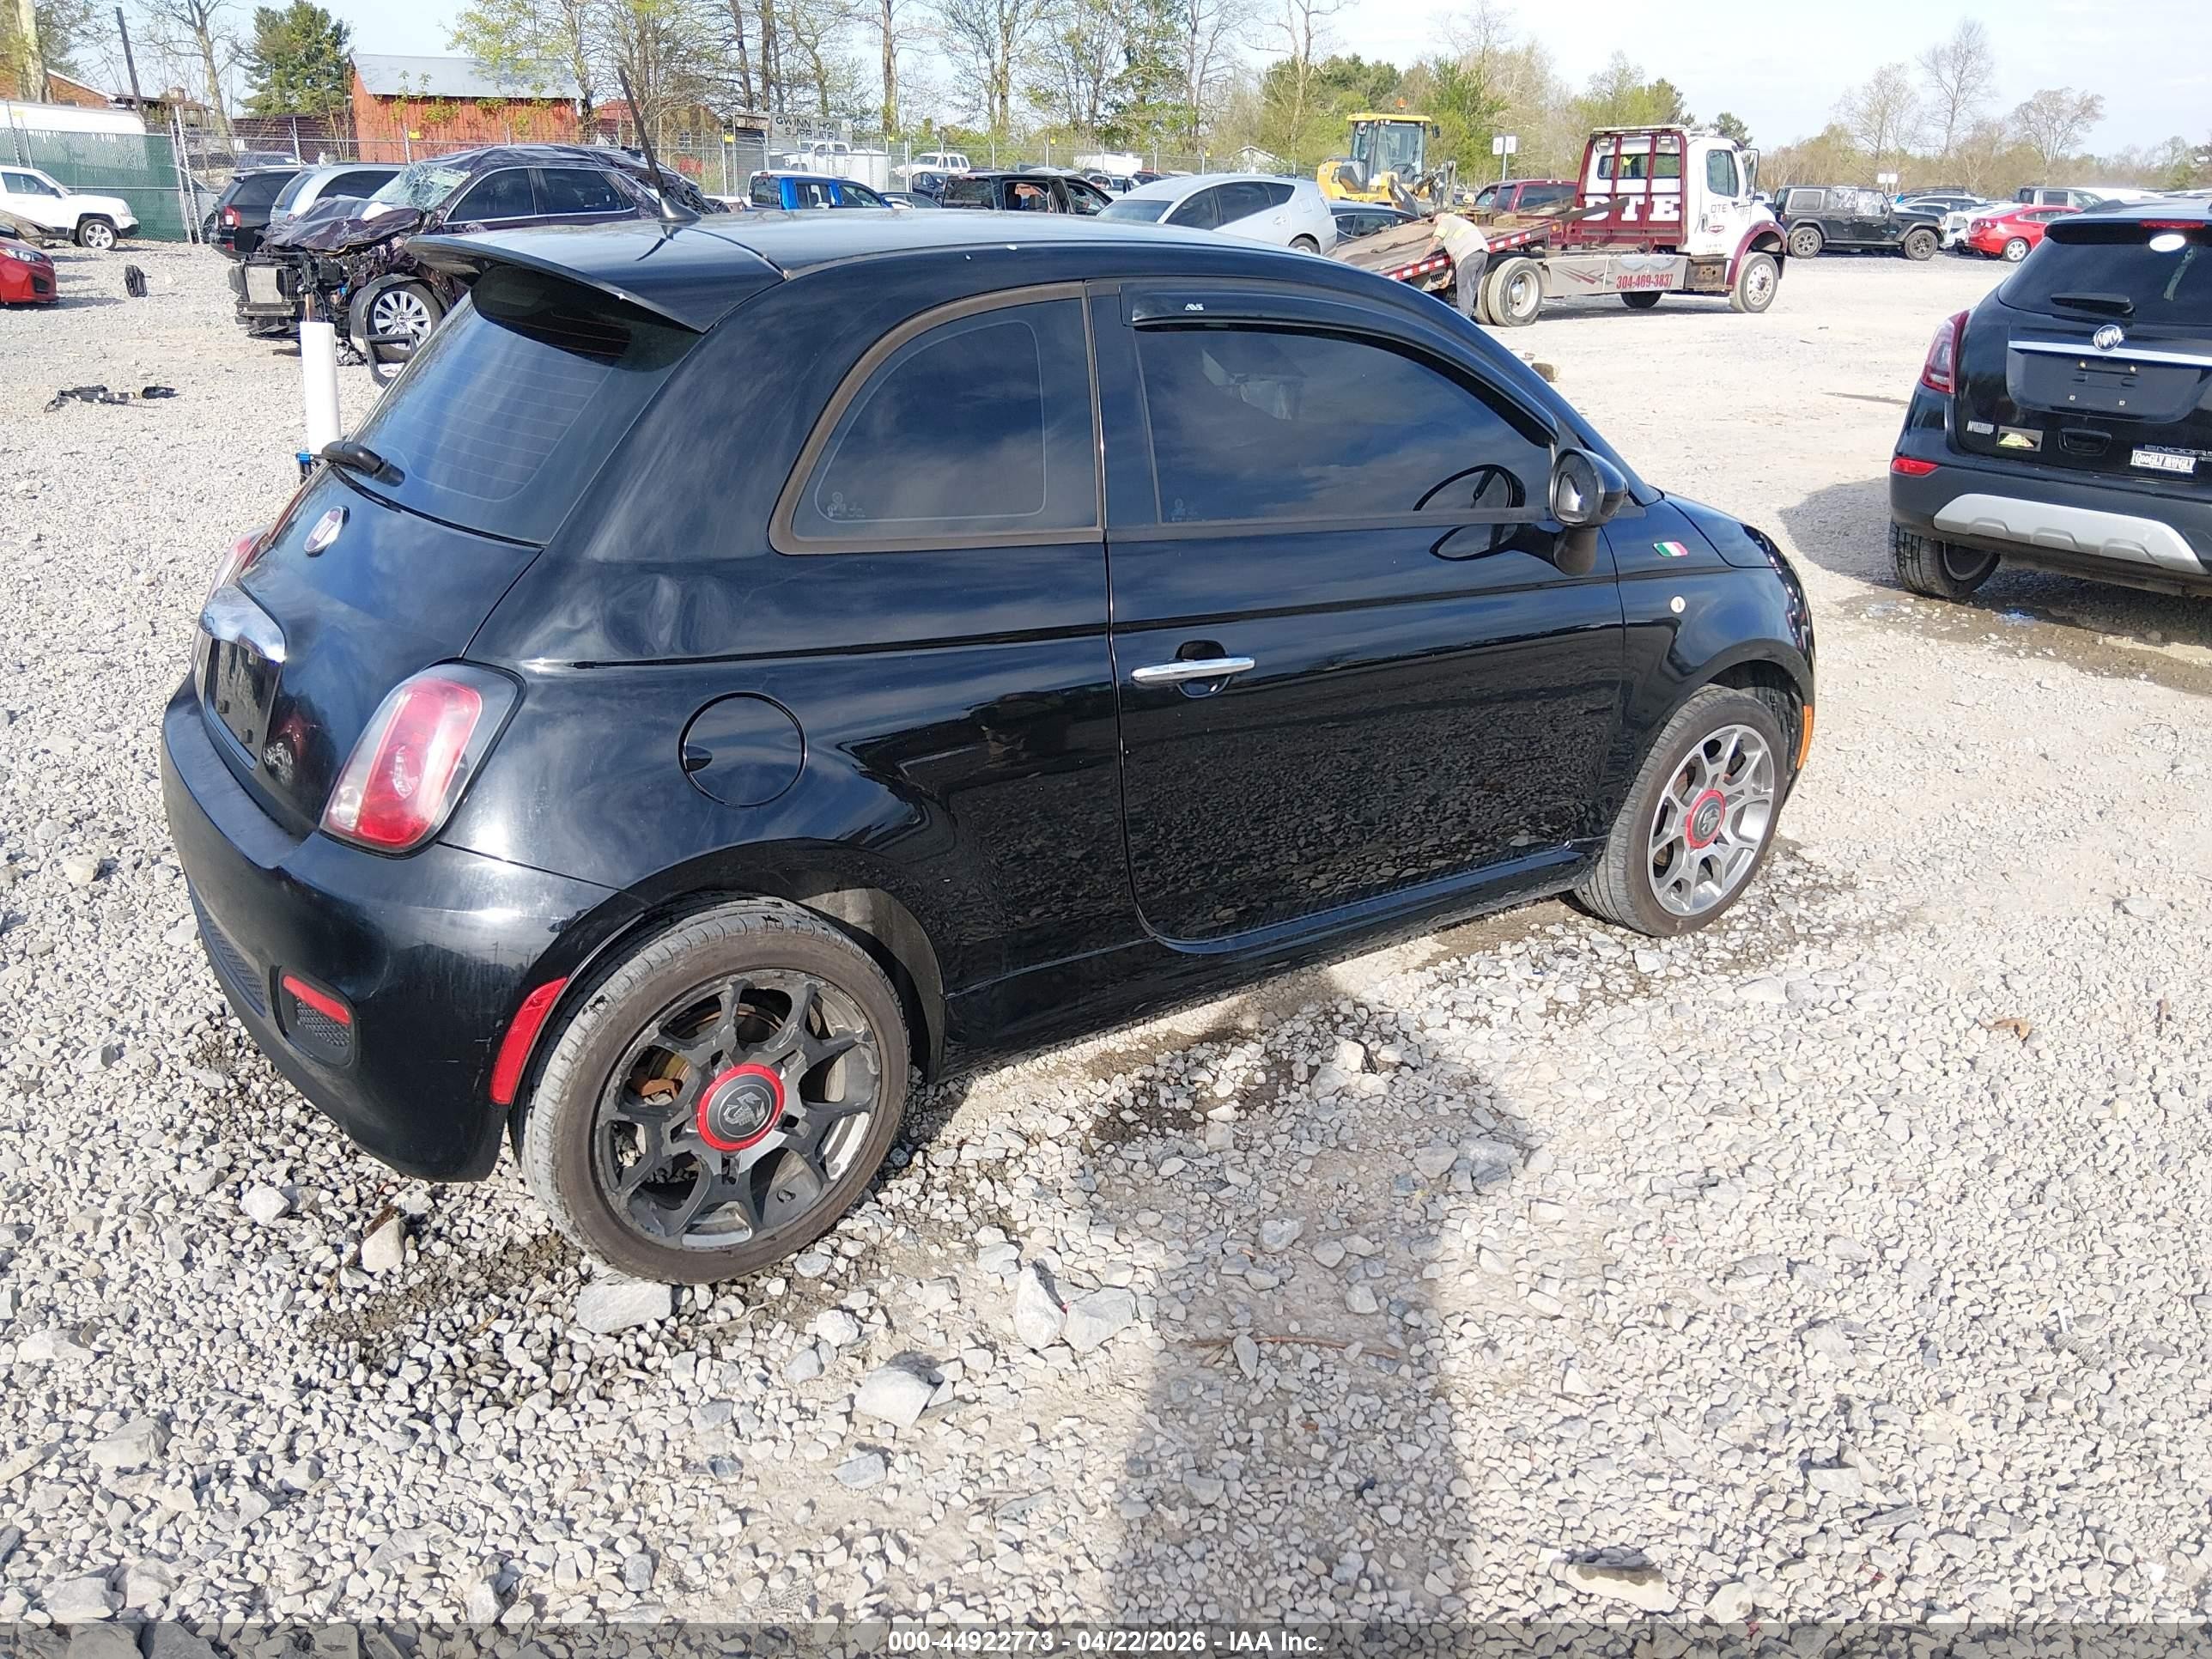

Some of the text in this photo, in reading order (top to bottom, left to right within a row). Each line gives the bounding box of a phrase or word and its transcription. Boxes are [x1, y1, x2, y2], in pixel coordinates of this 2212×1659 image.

[775, 116, 811, 129] GWINN
[1582, 195, 1680, 221] DTE
[1616, 274, 1674, 289] 304-469-3837
